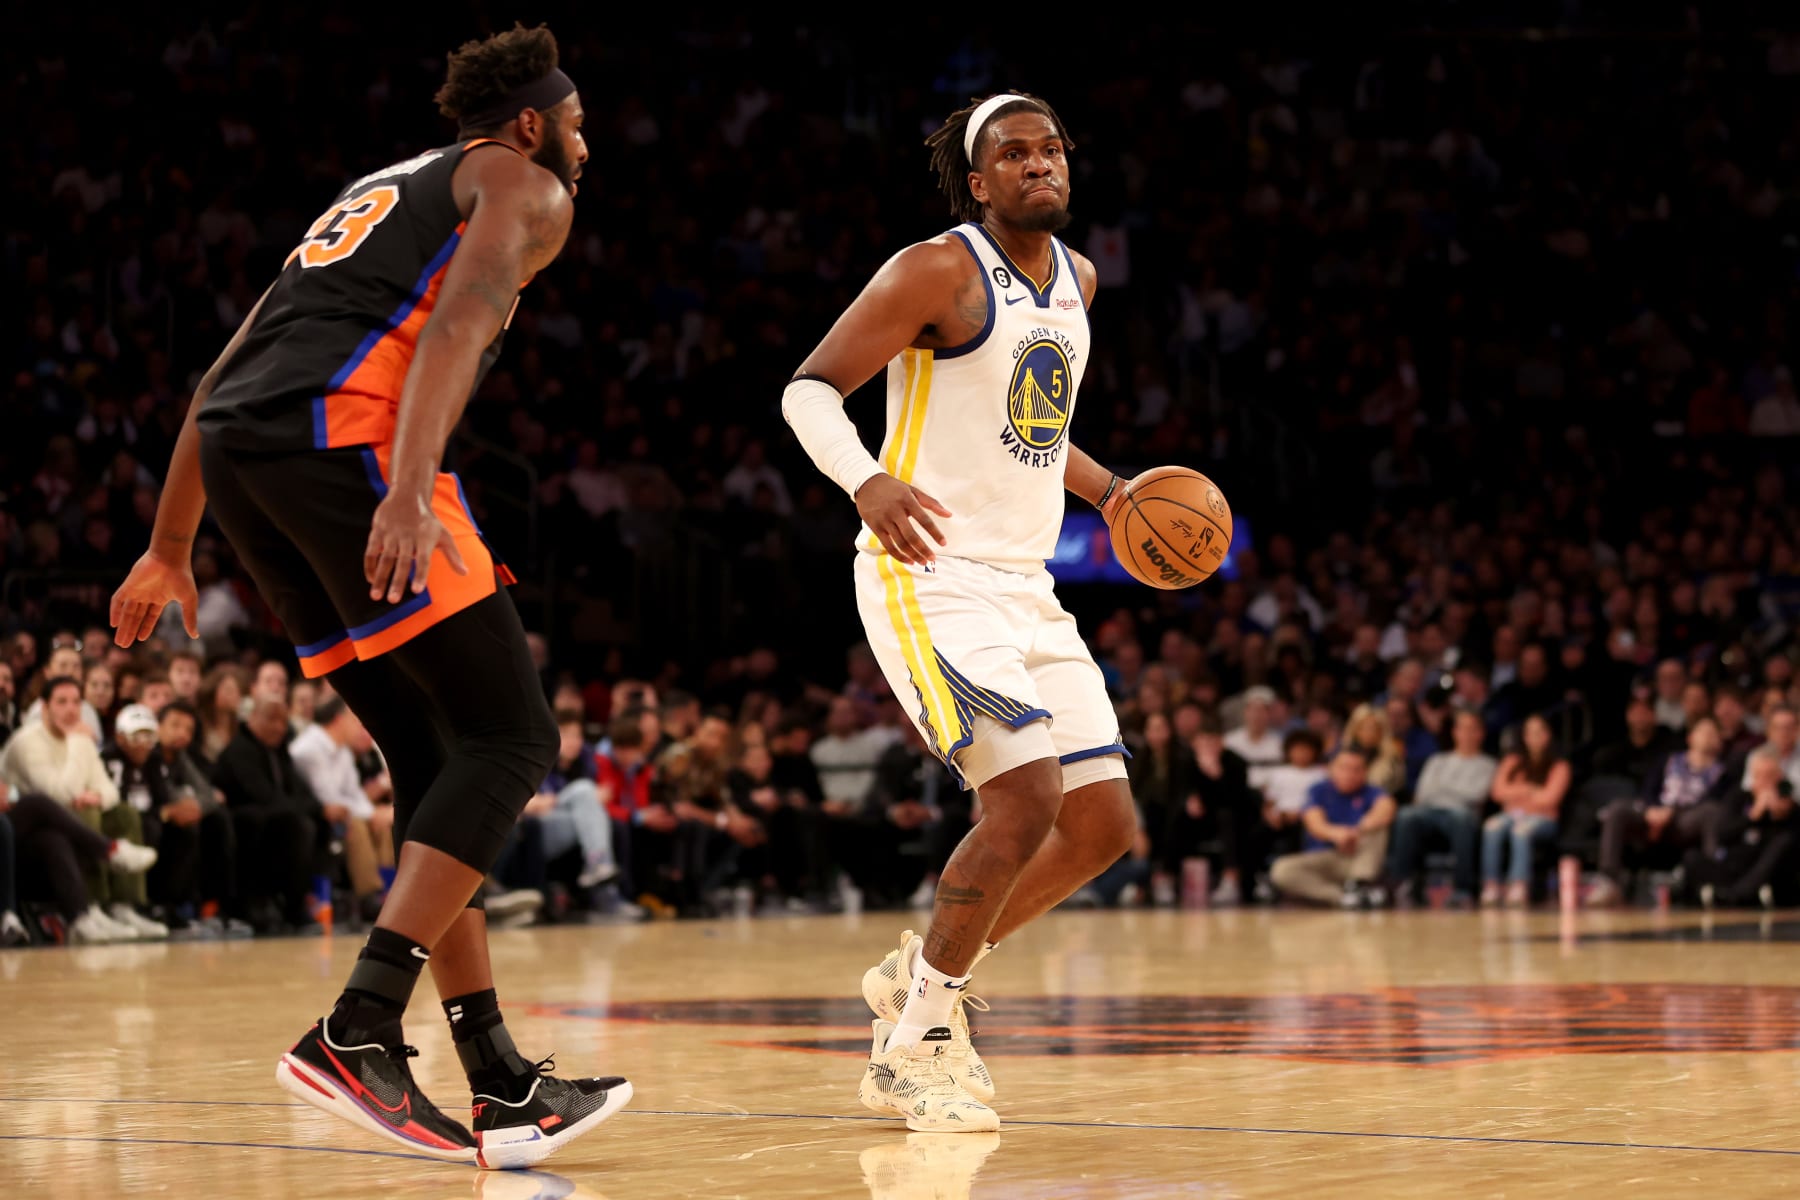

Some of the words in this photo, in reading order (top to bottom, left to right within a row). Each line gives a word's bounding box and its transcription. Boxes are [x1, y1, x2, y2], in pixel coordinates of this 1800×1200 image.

[995, 270, 1008, 287] 6
[1012, 327, 1051, 360] GOLDEN
[1054, 330, 1077, 364] STATE
[1051, 369, 1063, 399] 5
[999, 424, 1067, 469] WARRIO
